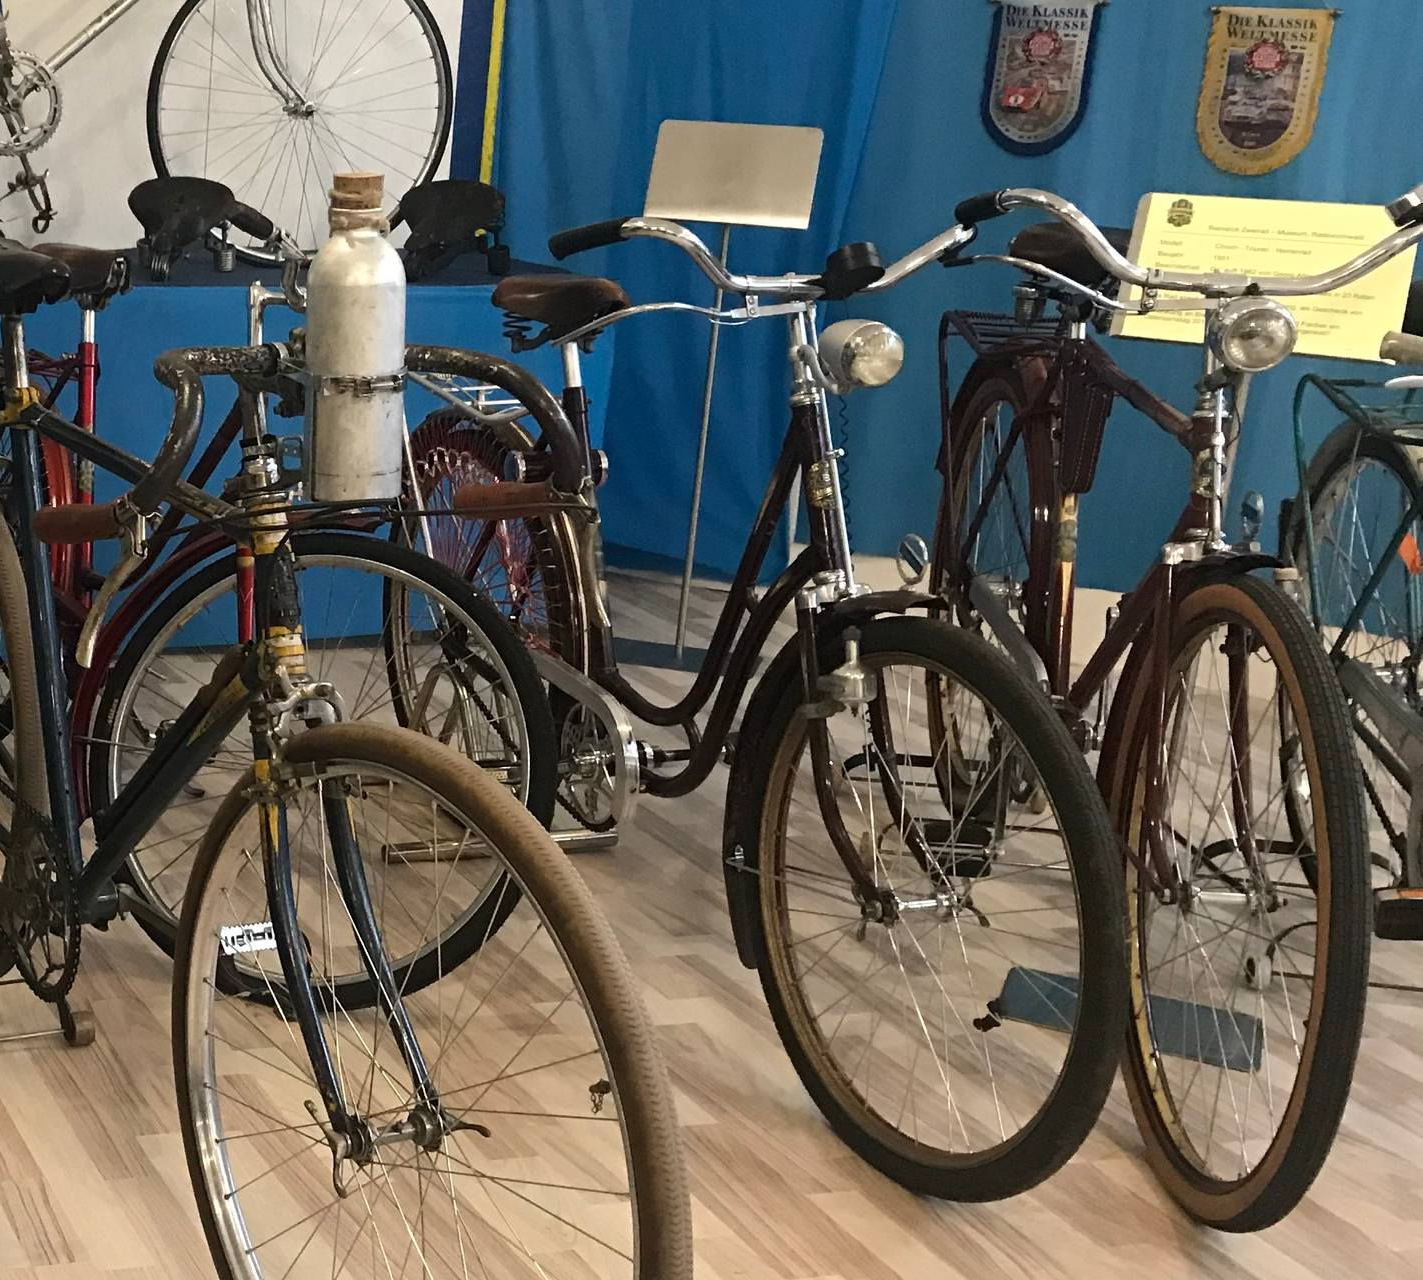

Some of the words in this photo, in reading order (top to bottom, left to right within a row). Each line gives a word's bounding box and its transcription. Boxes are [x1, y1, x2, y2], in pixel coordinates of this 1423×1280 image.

[1033, 5, 1088, 19] KLASSIK
[1005, 16, 1088, 31] WELTMESSE
[1257, 15, 1317, 30] KLASSIK
[1227, 26, 1317, 42] WELTMESSE
